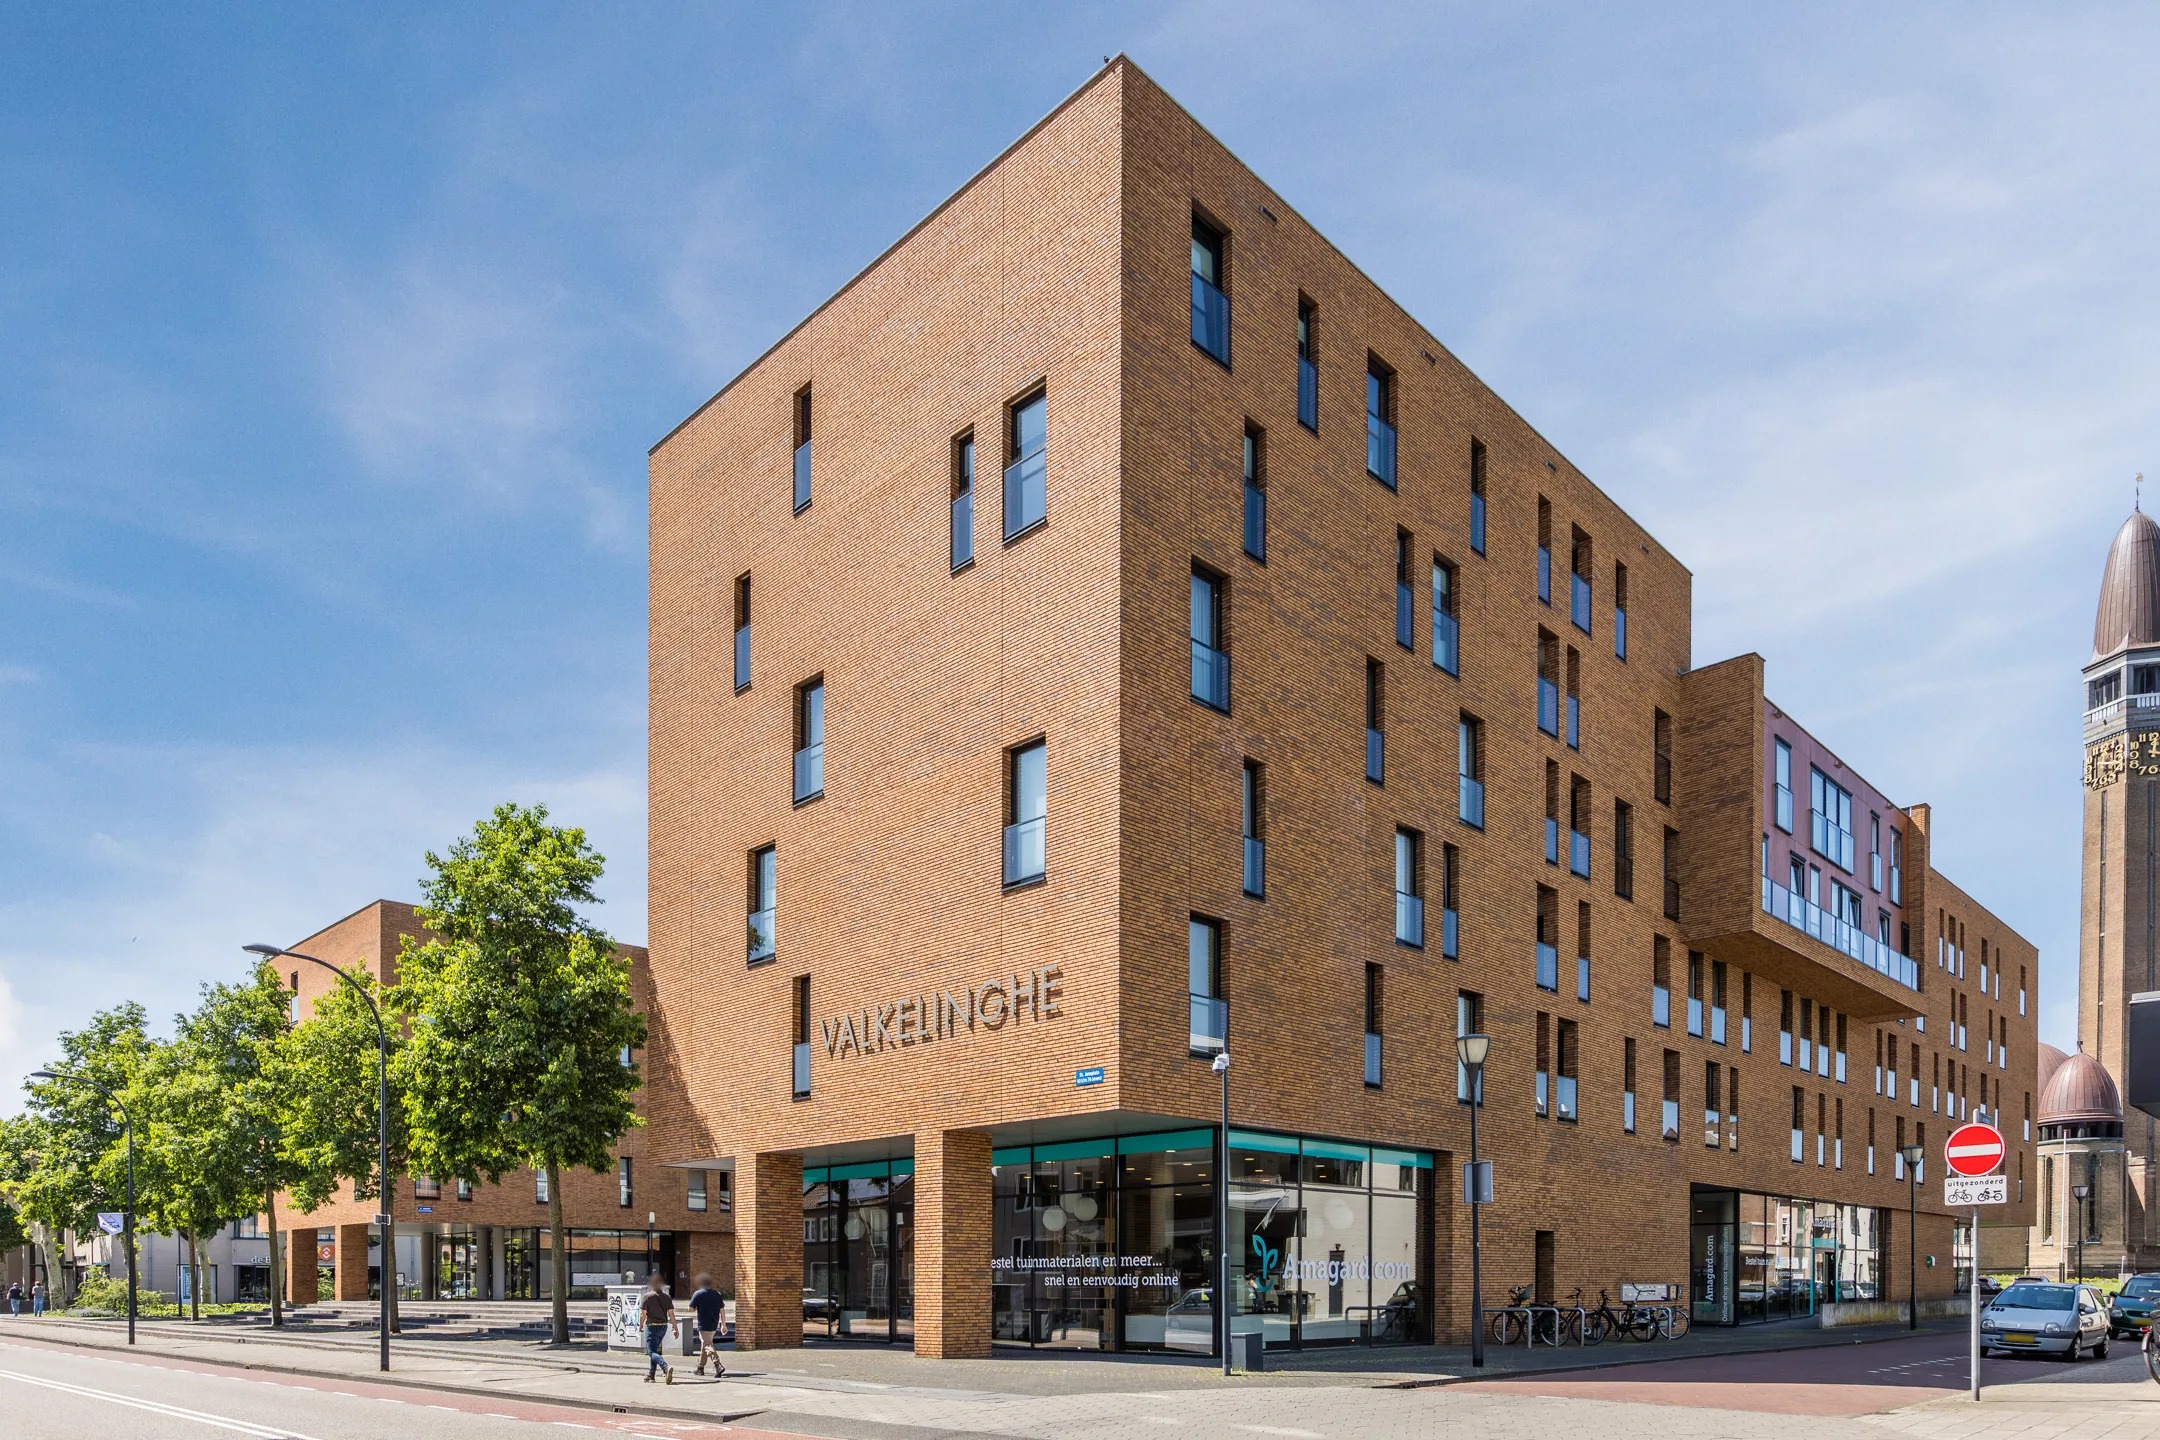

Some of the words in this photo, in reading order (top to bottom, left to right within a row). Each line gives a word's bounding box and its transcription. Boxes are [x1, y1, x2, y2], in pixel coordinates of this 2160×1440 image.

[2138, 733, 2146, 742] 11
[2115, 744, 2123, 753] 2
[2129, 741, 2139, 750] 10
[2129, 750, 2139, 760] 9
[2129, 760, 2139, 769] 8
[2138, 765, 2148, 776] 7
[2148, 765, 2159, 775] 6
[819, 963, 1059, 1053] VALKELINGHE
[1947, 1178, 2004, 1188] uitgezonderd
[251, 1255, 263, 1264] de
[991, 1255, 1014, 1269] estel
[1016, 1254, 1100, 1268] tuinmaterialen
[1102, 1255, 1117, 1267] en
[1120, 1255, 1162, 1267] meer...
[1282, 1252, 1410, 1286] Amagardcom
[1705, 1235, 1716, 1301] Amagard.com
[1044, 1273, 1065, 1286] snel
[1067, 1275, 1081, 1286] en
[1082, 1272, 1139, 1289] eenvoudig
[1141, 1273, 1179, 1286] online
[1722, 1286, 1730, 1301] shop
[1721, 1302, 1729, 1322] Online
